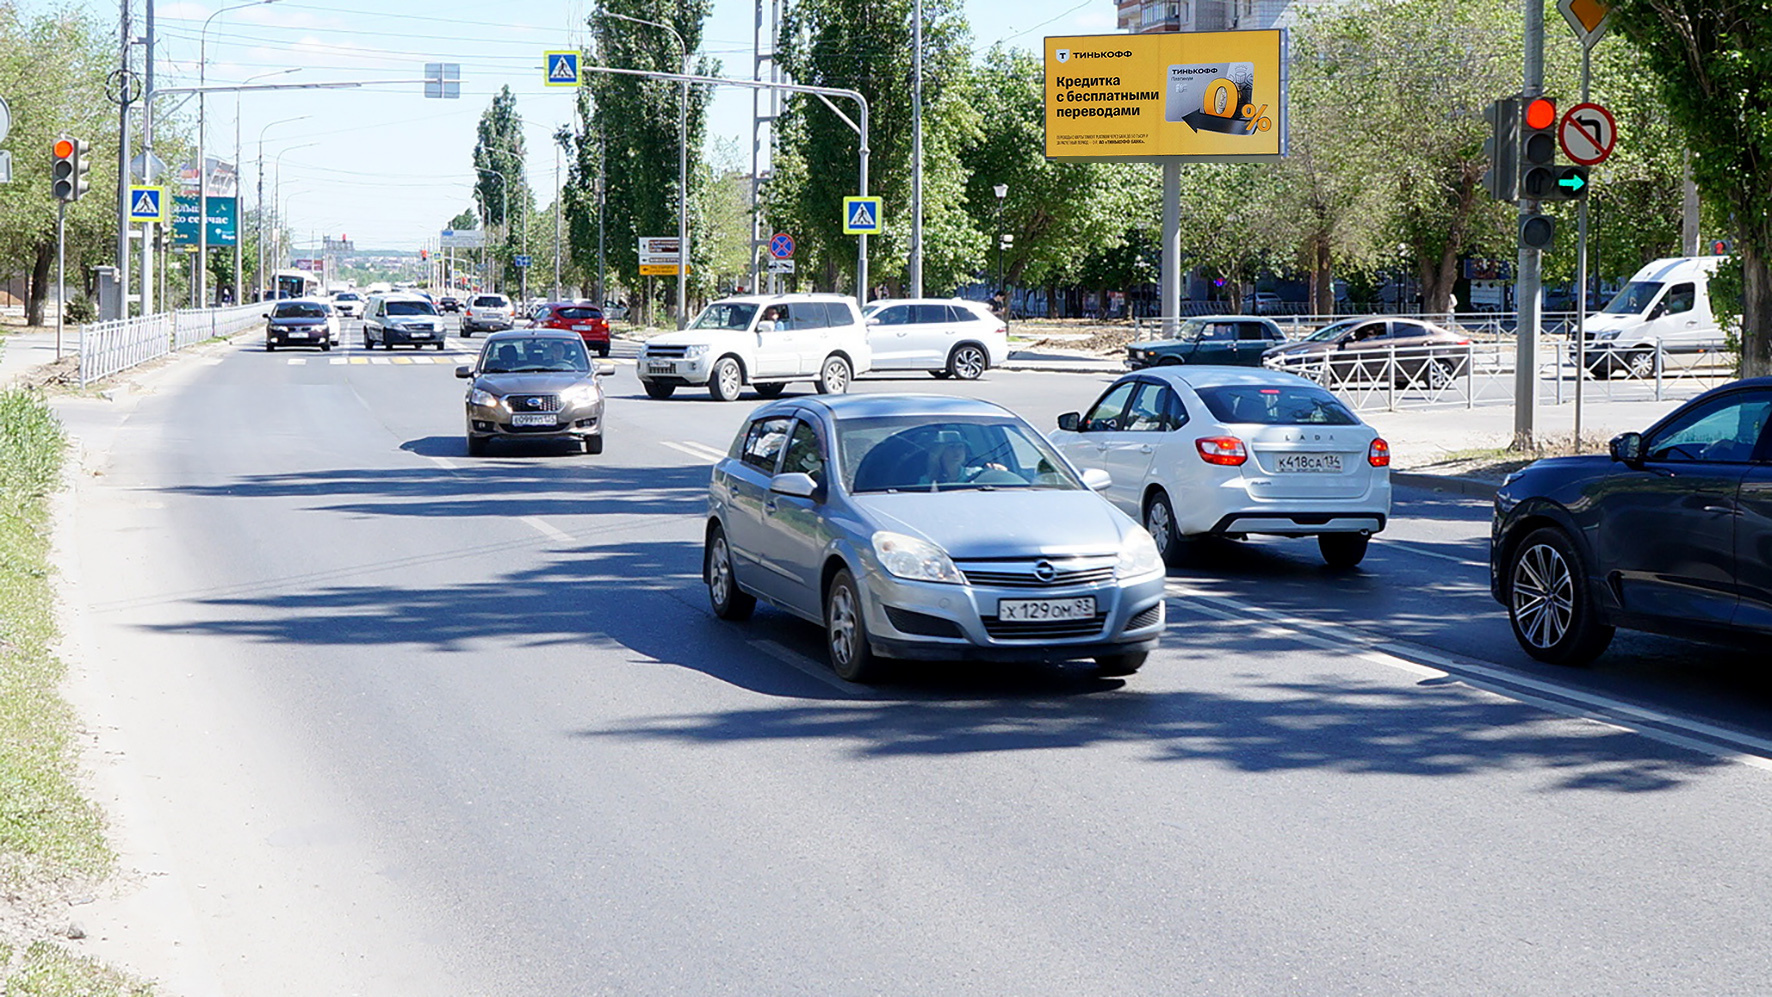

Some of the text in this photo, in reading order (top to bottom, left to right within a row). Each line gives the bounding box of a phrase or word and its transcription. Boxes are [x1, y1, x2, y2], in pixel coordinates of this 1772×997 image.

[1073, 50, 1132, 59] ТИНЬКОФФ
[1056, 75, 1121, 89] Кредитка
[1056, 90, 1160, 103] с бесплатными
[1056, 106, 1141, 119] переводами
